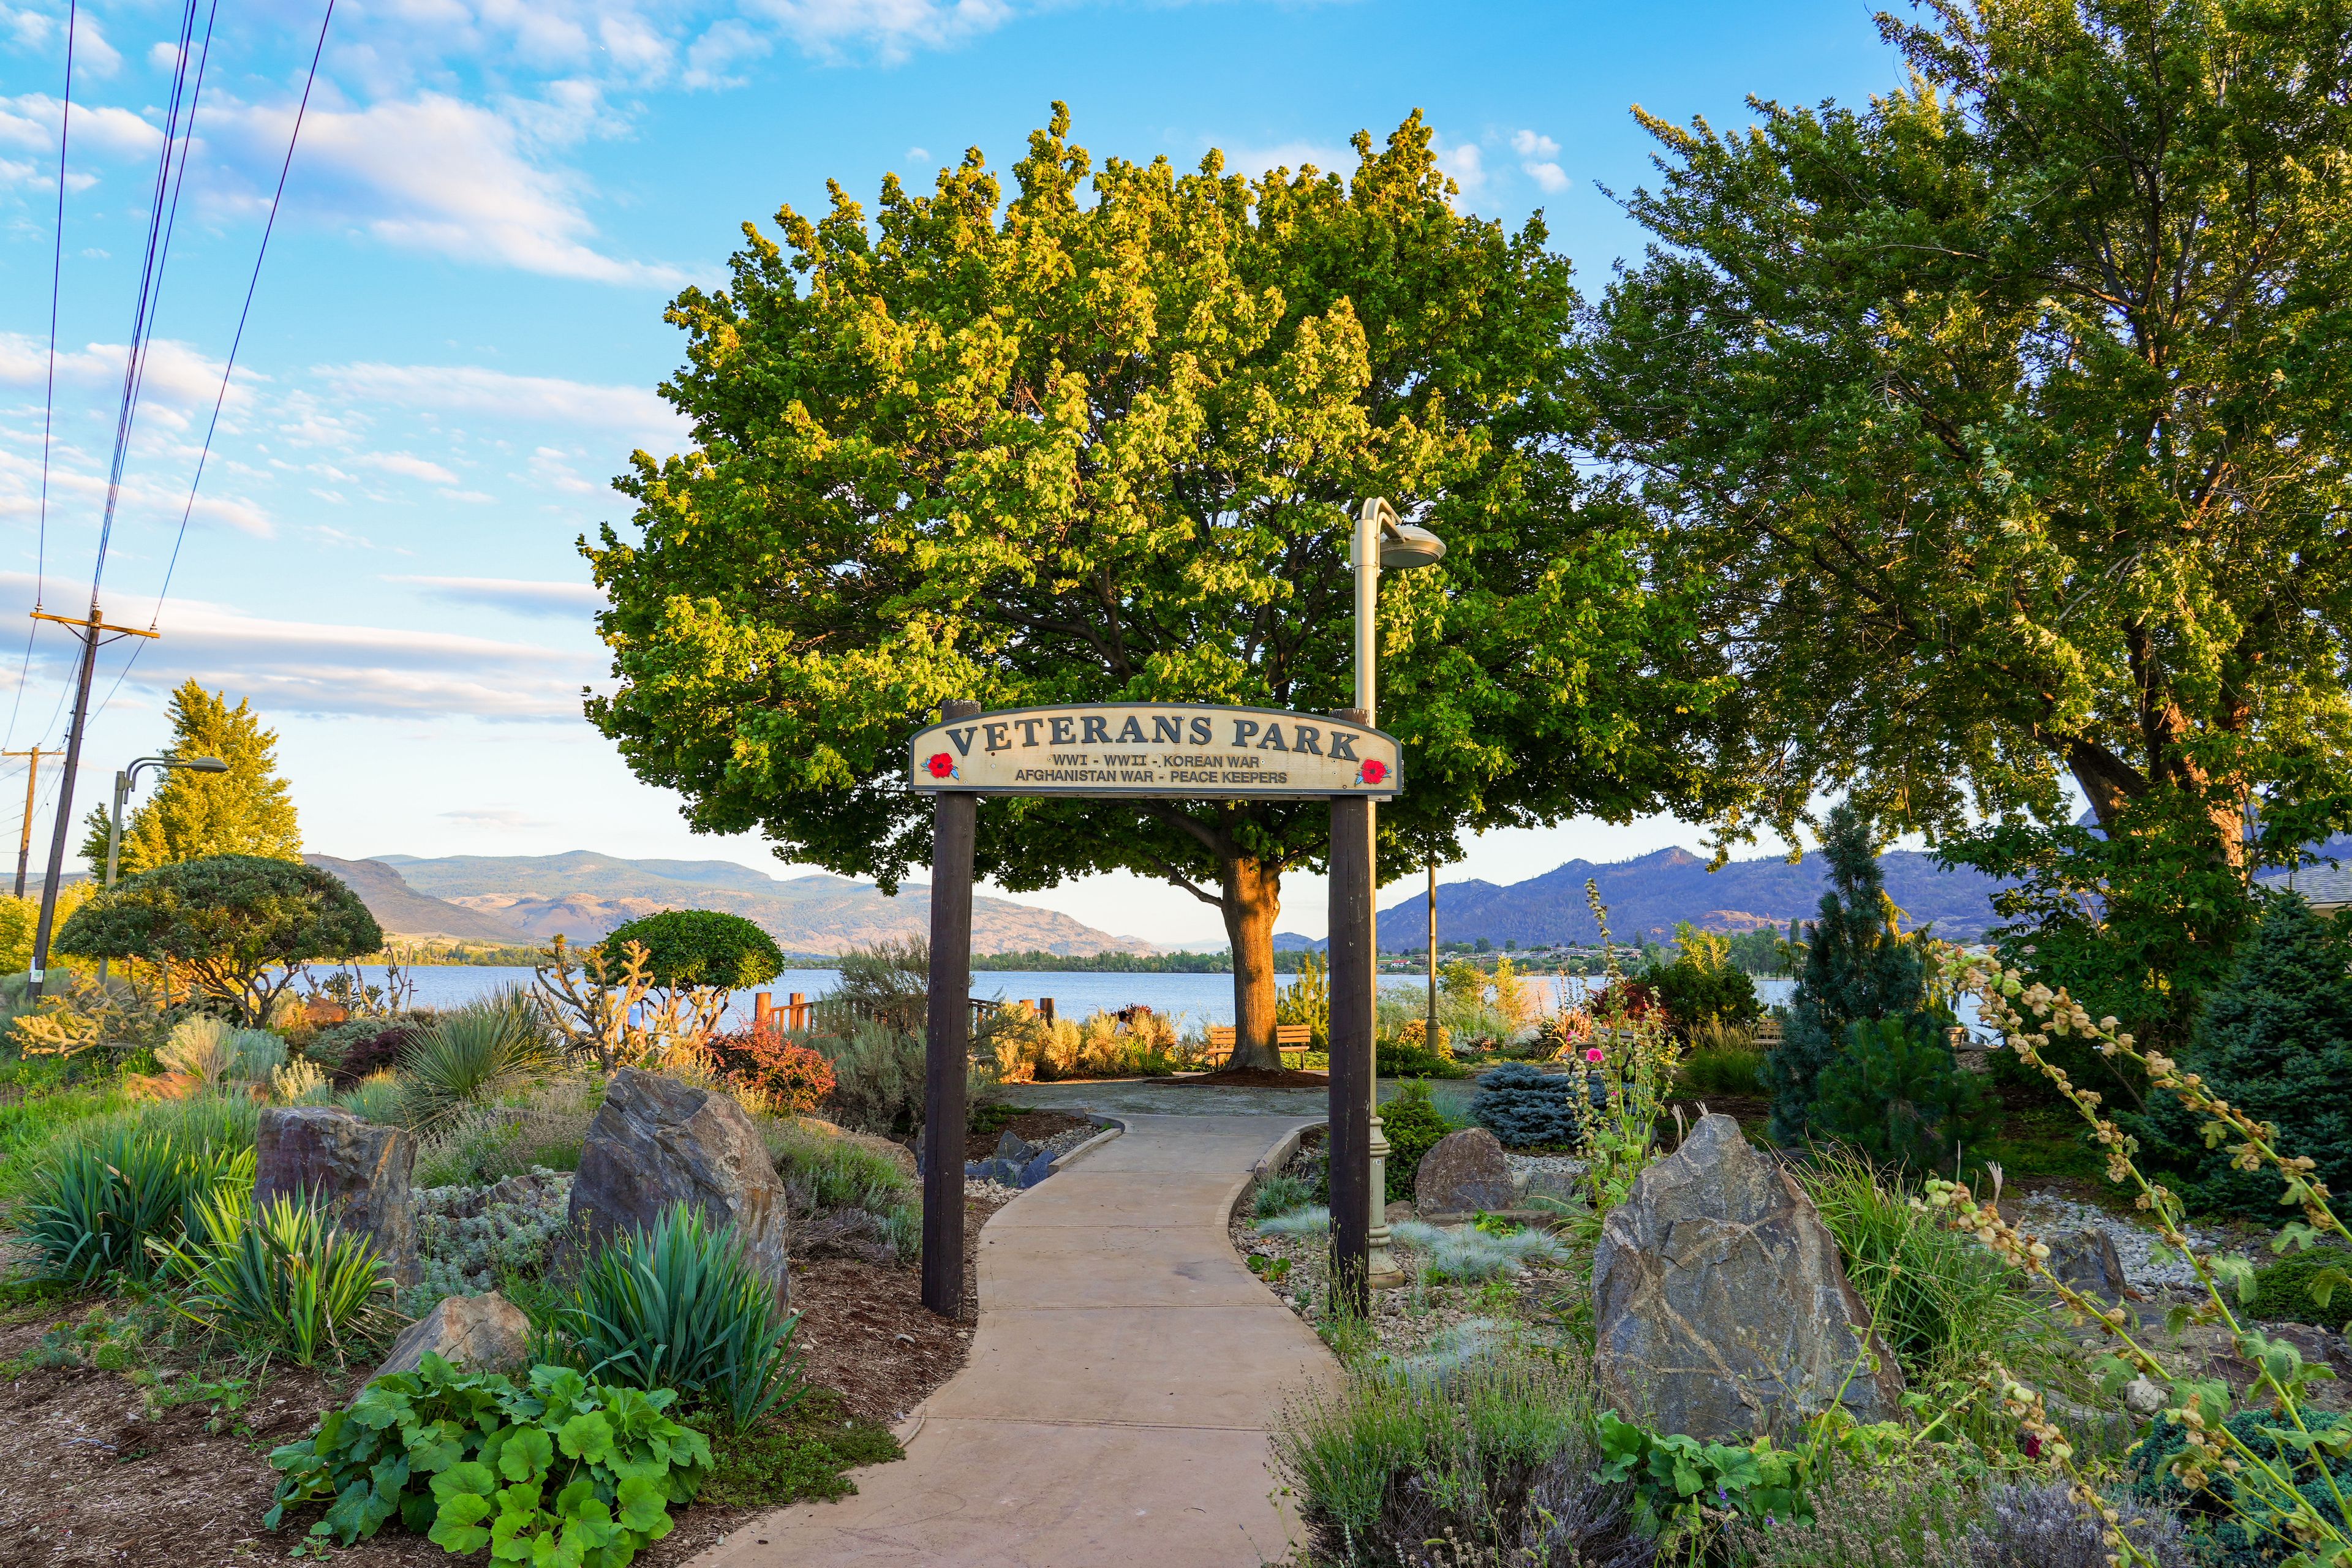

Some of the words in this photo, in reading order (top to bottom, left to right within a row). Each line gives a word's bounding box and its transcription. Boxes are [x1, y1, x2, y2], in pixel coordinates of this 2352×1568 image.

[945, 715, 1213, 756] VETERANS
[1232, 719, 1360, 762] PARK
[1052, 754, 1088, 766] WWI
[1103, 754, 1147, 766] WWII
[1164, 755, 1223, 767] KOREAN
[1226, 756, 1260, 767] WAR
[1015, 769, 1117, 782] AFGHANISTAN
[1120, 770, 1154, 782] WAR
[1170, 771, 1218, 783] PEACE
[1223, 771, 1287, 783] KEEPERS
